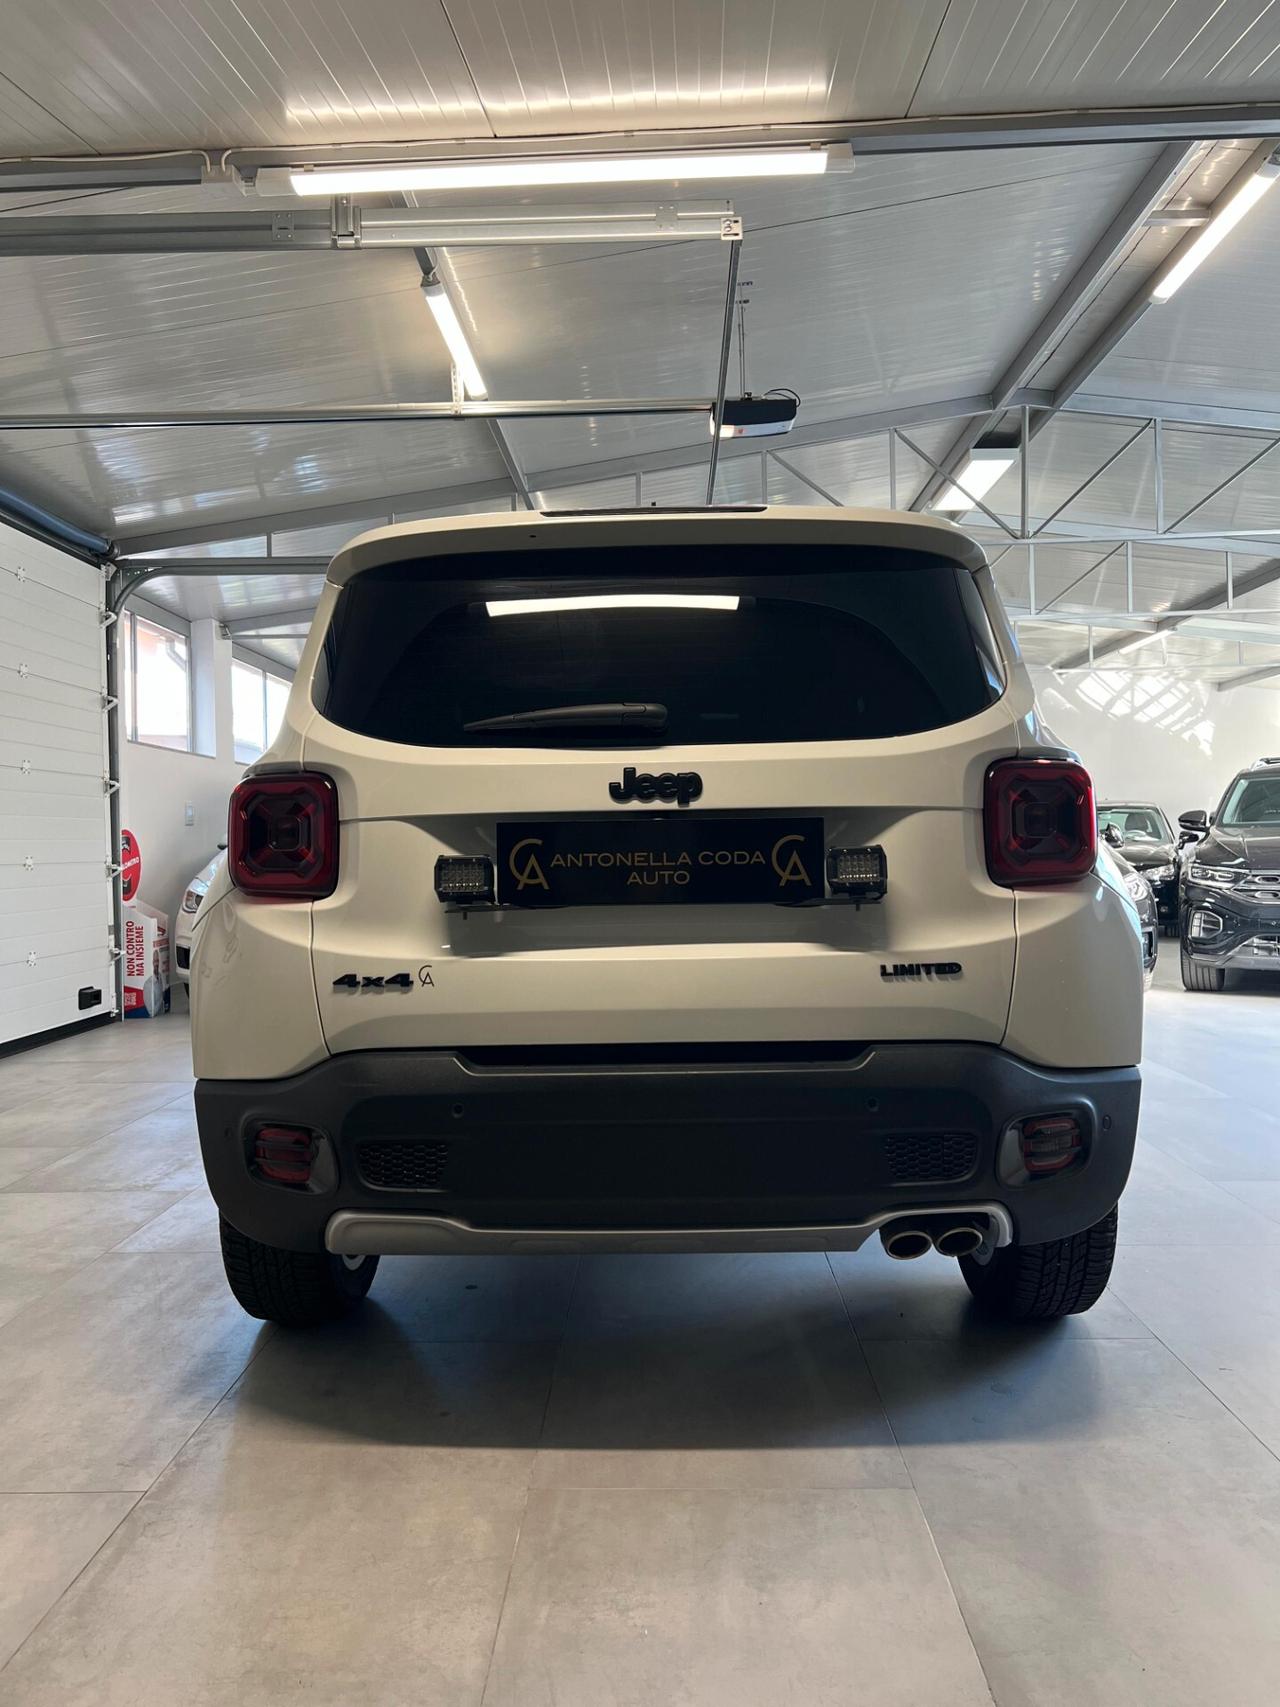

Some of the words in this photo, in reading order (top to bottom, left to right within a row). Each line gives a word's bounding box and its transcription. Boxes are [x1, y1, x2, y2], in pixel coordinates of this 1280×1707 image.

[609, 767, 703, 808] Jeep
[550, 852, 692, 868] ANTONELLA
[698, 850, 766, 865] CODA
[627, 870, 690, 885] AUTO
[125, 920, 135, 957] CONTRO
[135, 925, 144, 961] INSIEME
[126, 957, 136, 977] NON
[136, 962, 145, 977] MA
[880, 962, 962, 977] LIMITED
[332, 973, 414, 988] 4x4
